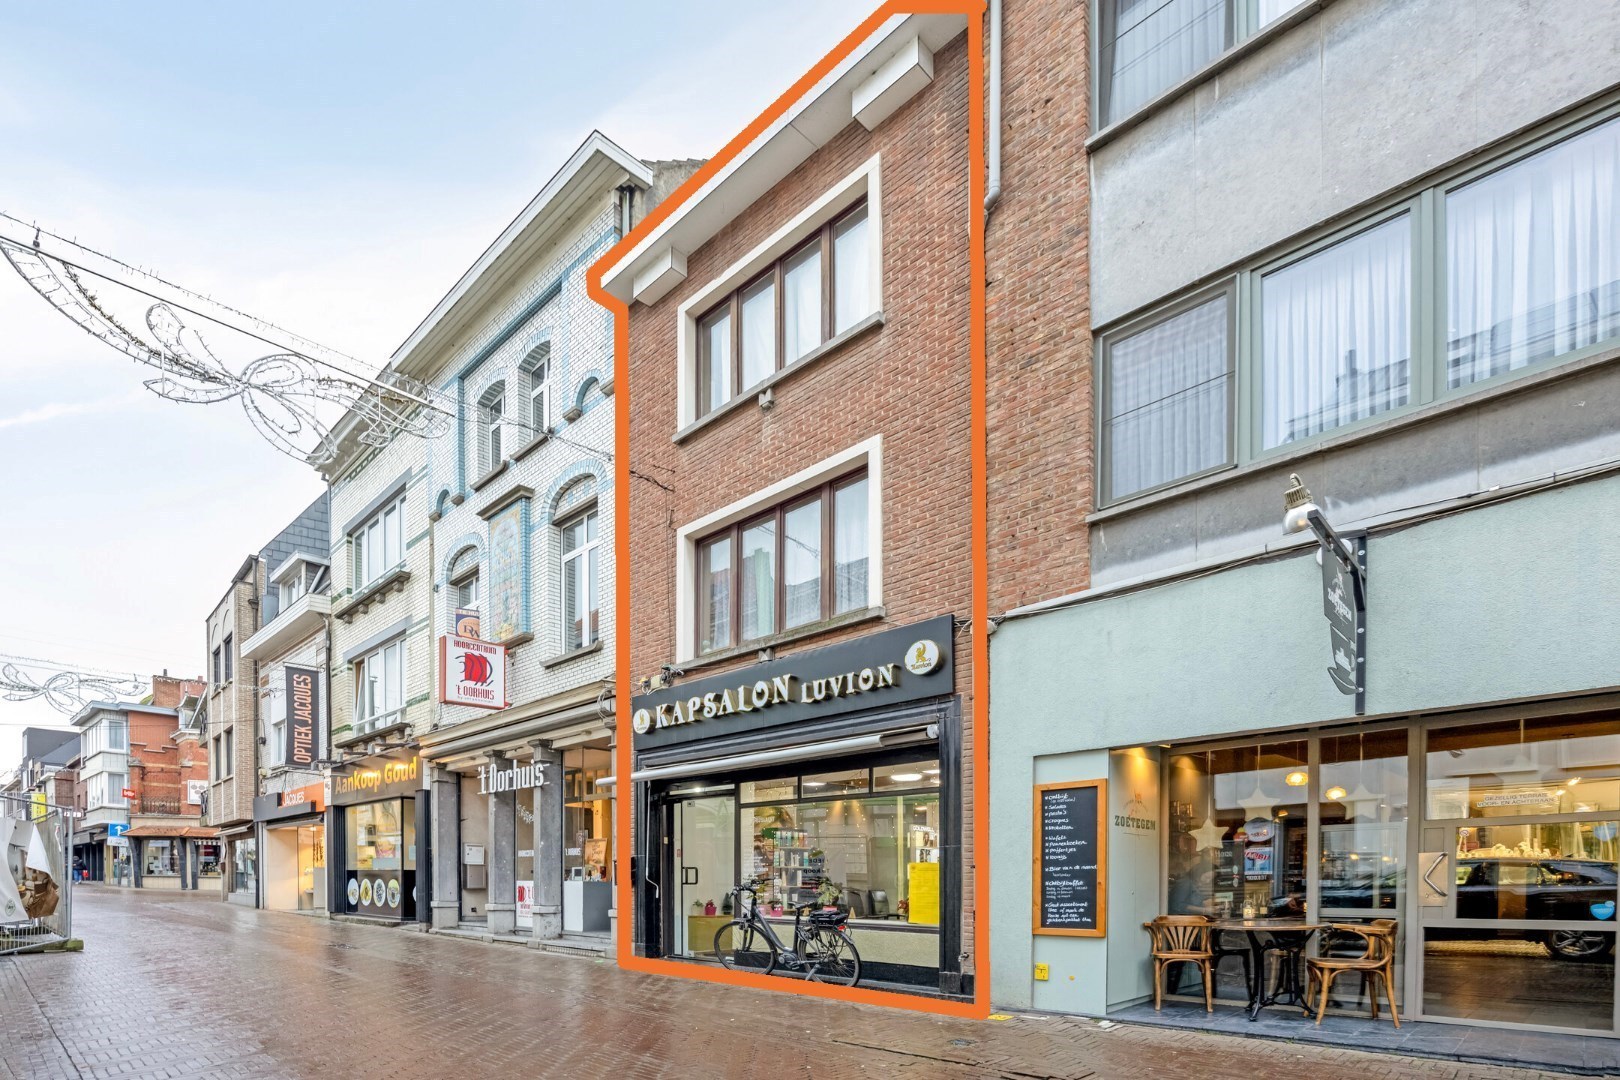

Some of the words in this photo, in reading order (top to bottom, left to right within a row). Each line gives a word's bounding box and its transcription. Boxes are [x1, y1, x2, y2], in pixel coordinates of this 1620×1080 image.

[294, 674, 312, 725] JACQUES
[655, 673, 791, 729] KAPSALON
[801, 662, 895, 703] LUVION
[294, 726, 312, 764] OPTIEK
[335, 770, 382, 795] Aankoop
[384, 756, 417, 785] Goud
[489, 759, 544, 793] Oorhuis
[1114, 815, 1156, 830] ZOETEGEM
